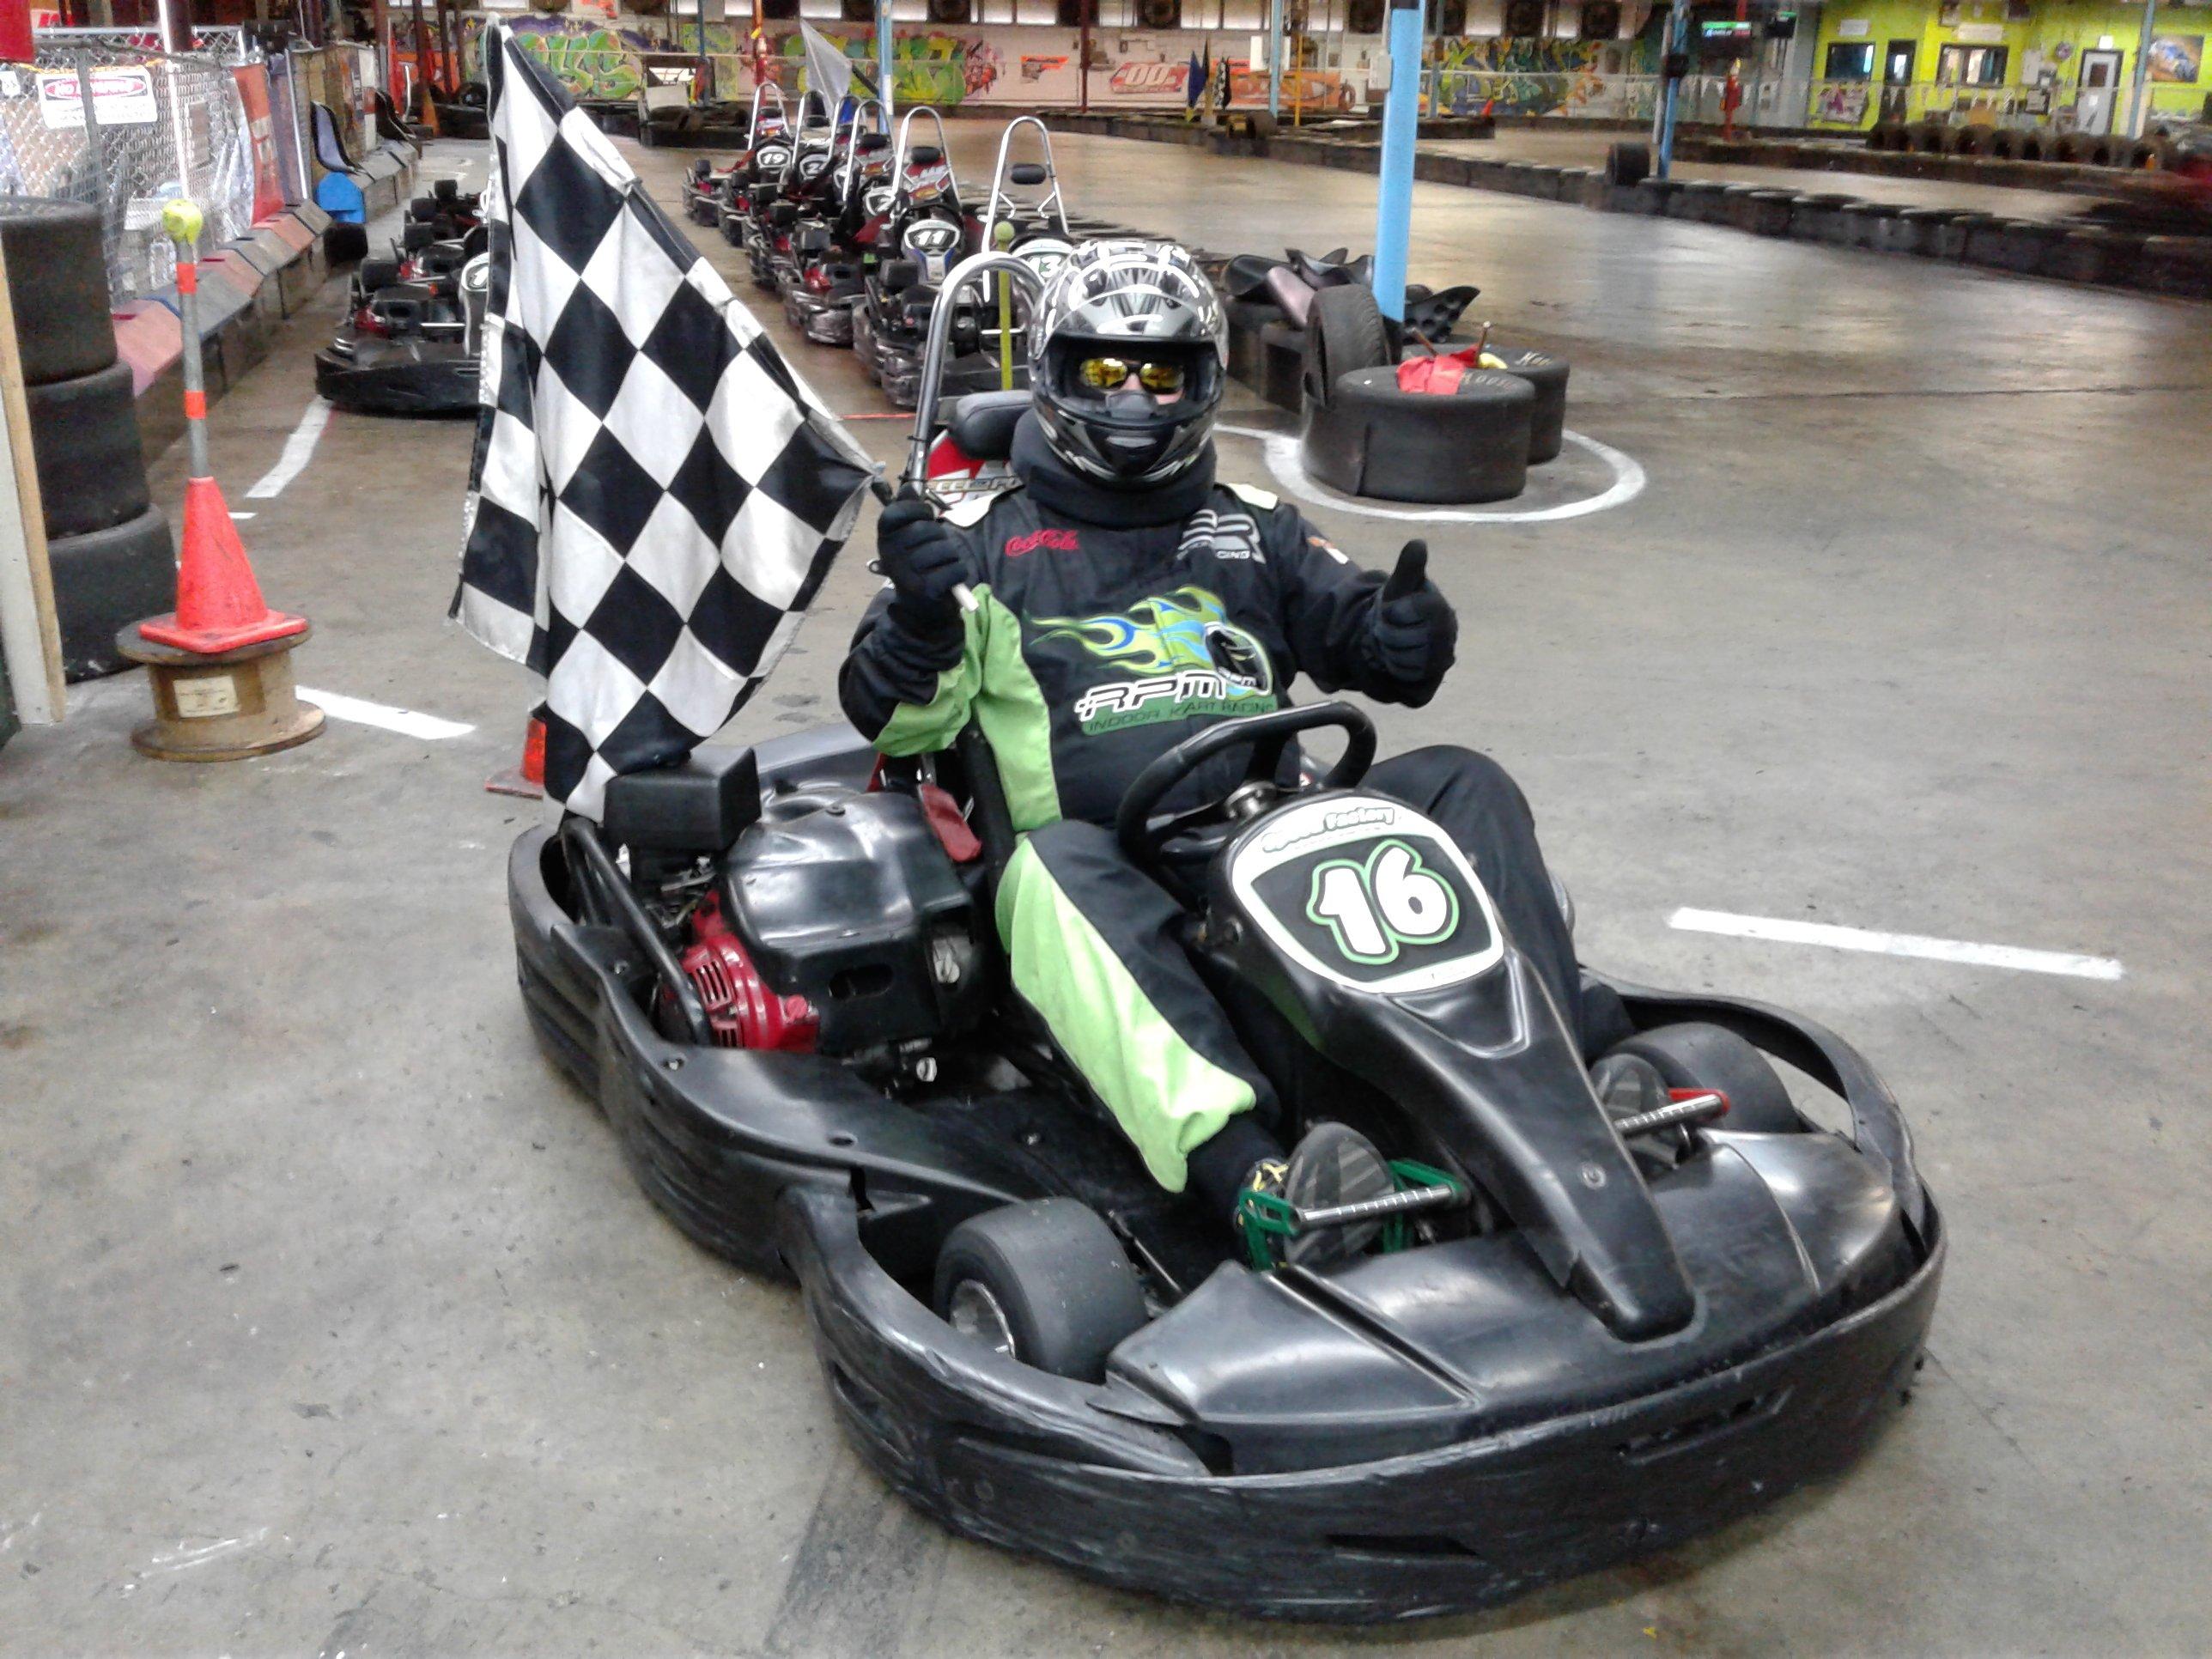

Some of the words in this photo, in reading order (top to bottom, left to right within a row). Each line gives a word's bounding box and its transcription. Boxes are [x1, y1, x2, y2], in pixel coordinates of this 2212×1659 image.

[763, 153, 785, 164] 19
[915, 230, 946, 246] 11
[1089, 709, 1160, 732] INDOOR
[1170, 700, 1217, 716] KART
[1314, 843, 1453, 959] 16
